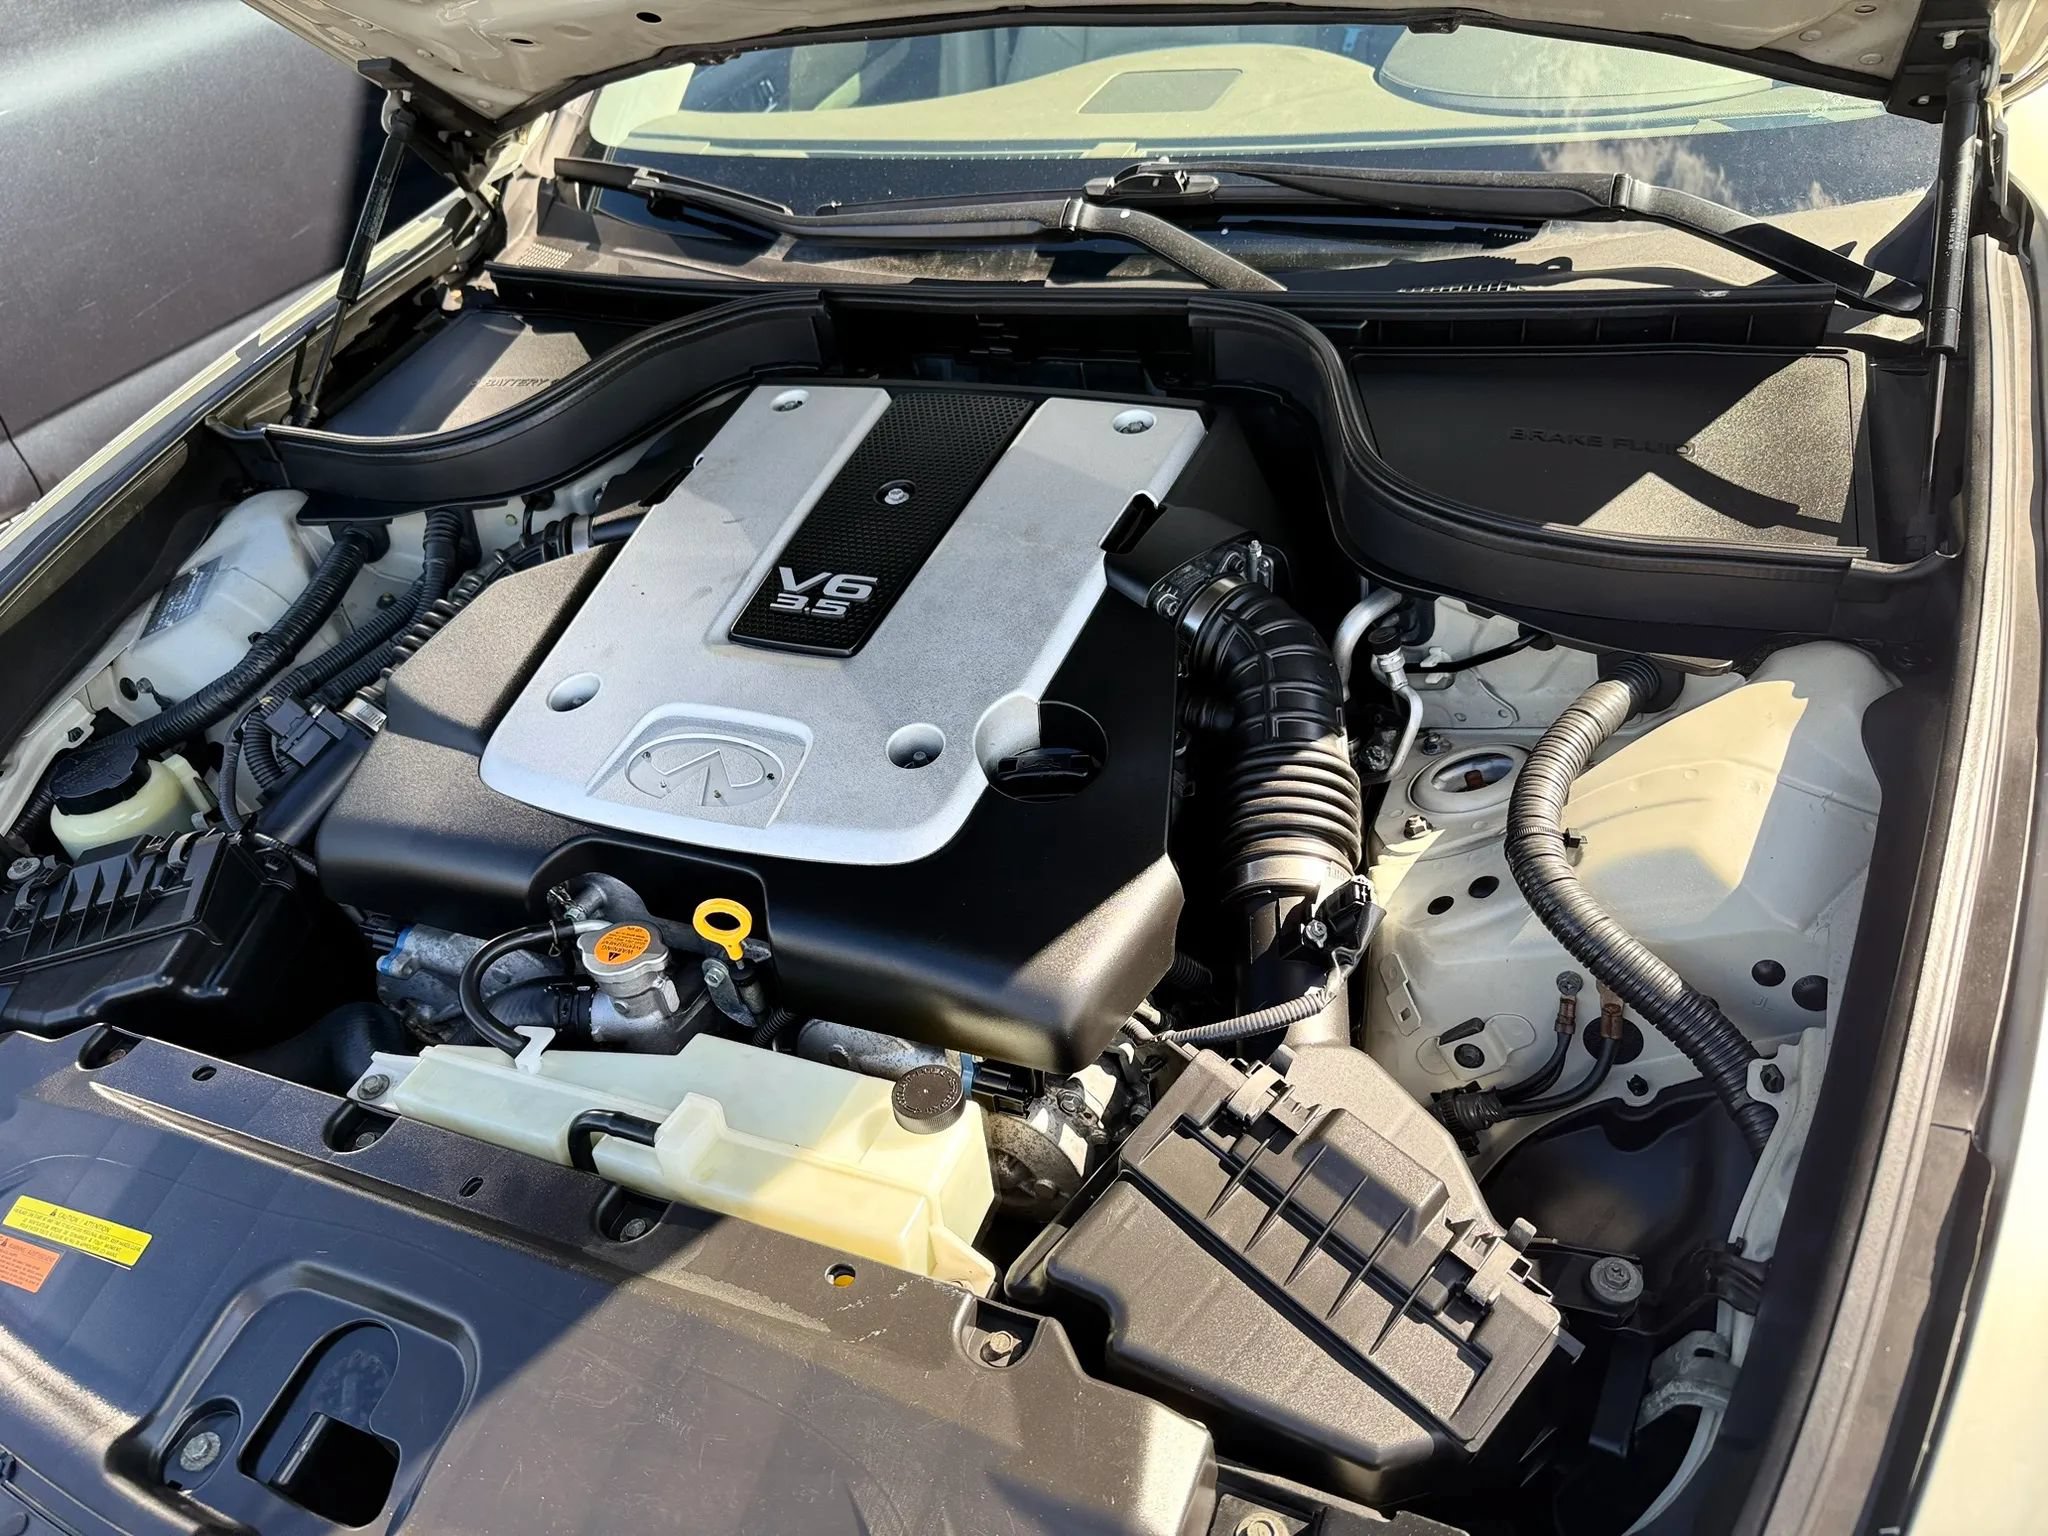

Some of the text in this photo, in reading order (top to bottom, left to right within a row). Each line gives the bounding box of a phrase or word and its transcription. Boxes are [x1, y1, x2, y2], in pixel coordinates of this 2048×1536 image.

[484, 377, 550, 387] BATTERY
[1510, 428, 1692, 455] BRAKE FLUID
[778, 566, 878, 601] V6
[769, 593, 850, 616] 3.5
[601, 944, 634, 956] WARNING
